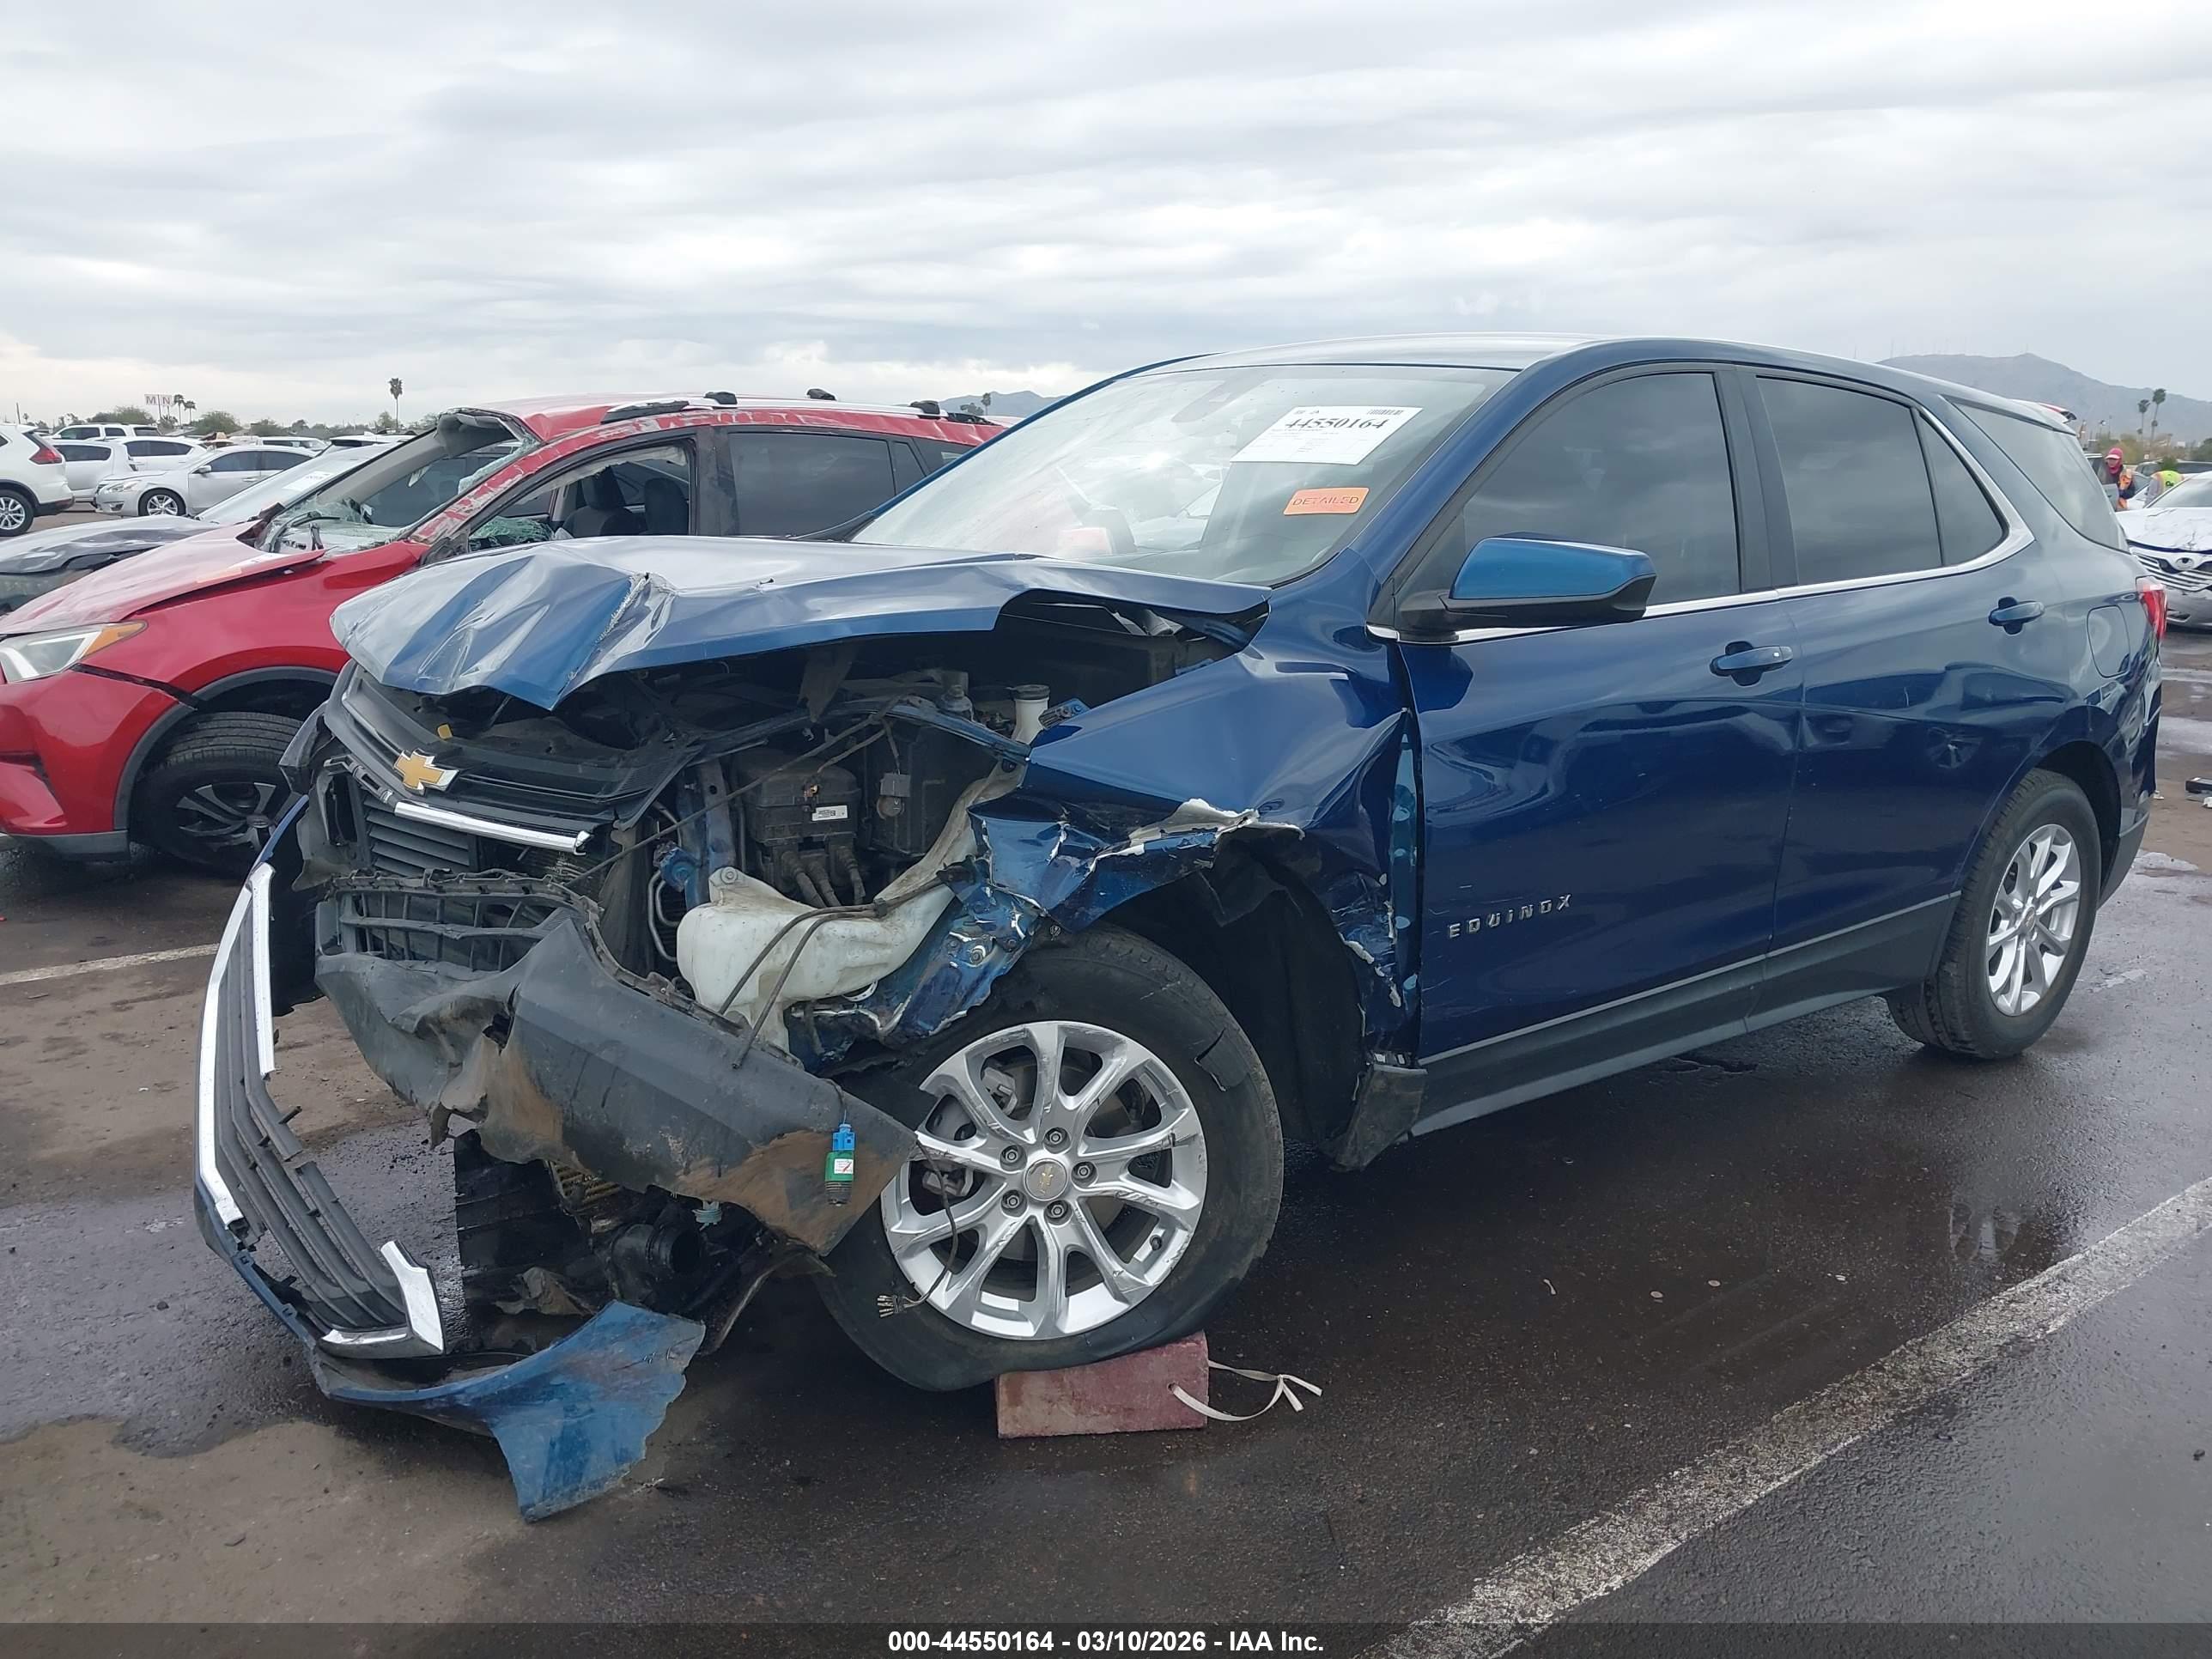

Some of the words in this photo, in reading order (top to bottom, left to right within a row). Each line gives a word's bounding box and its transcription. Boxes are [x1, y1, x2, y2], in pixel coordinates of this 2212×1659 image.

[1285, 417, 1389, 429] 44550164
[1292, 495, 1359, 506] DETAILED
[1447, 893, 1572, 939] EQUINOX
